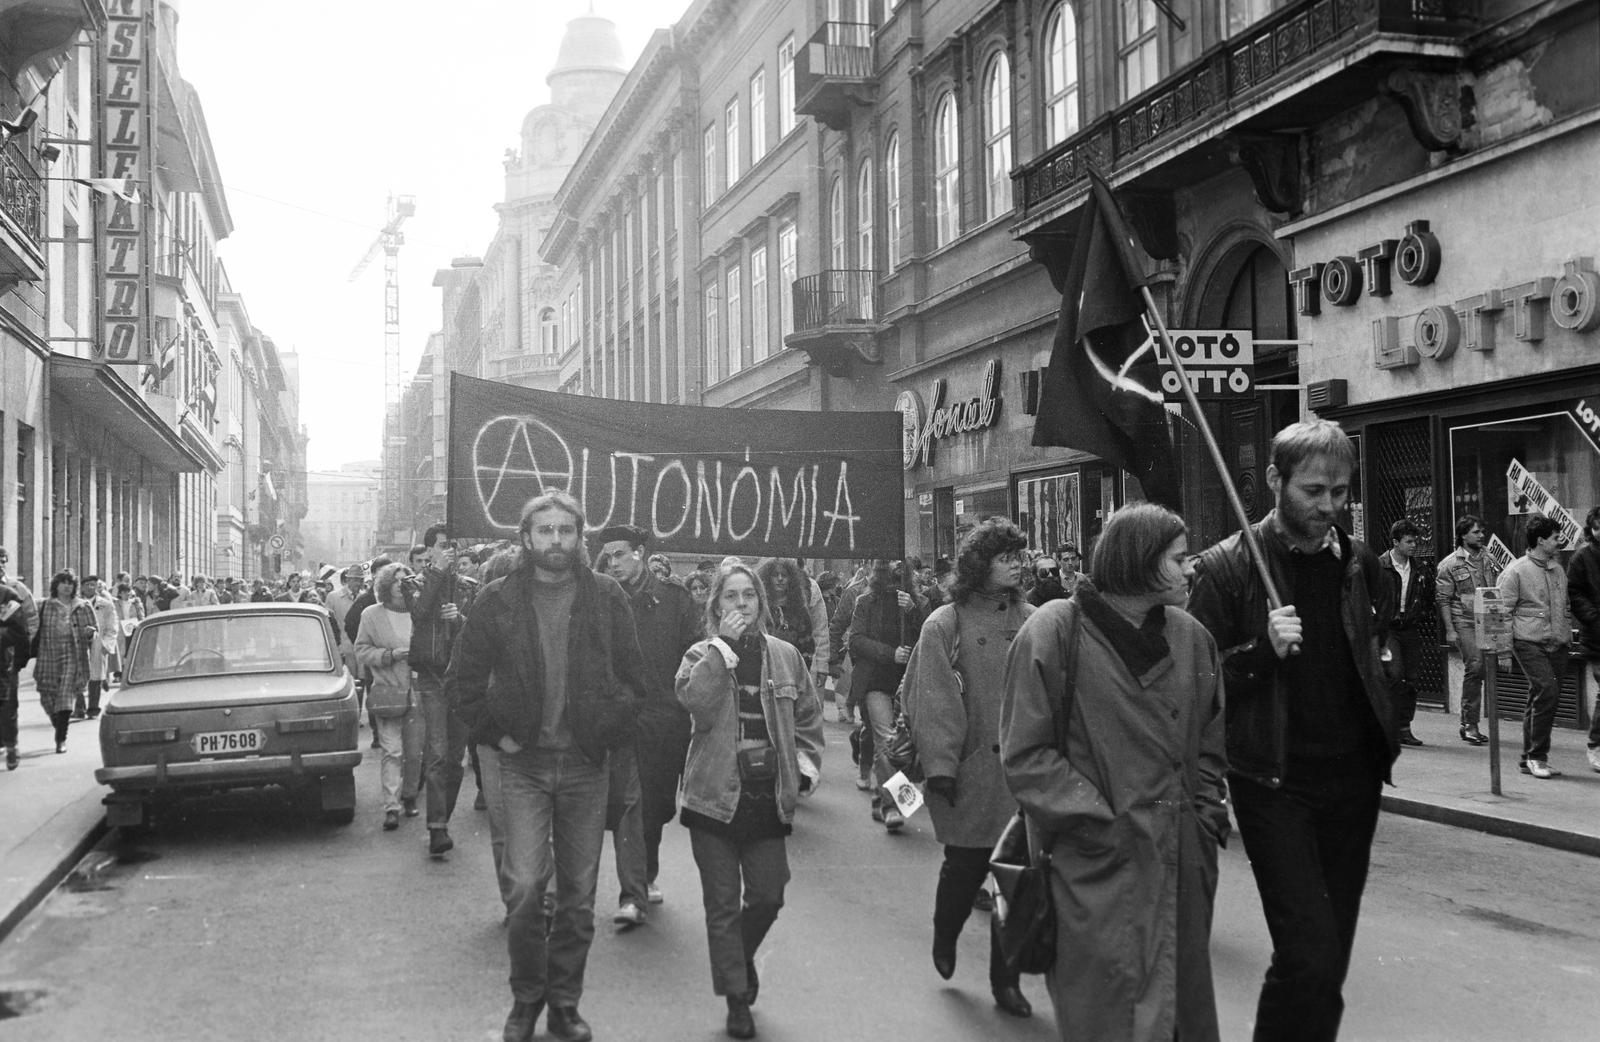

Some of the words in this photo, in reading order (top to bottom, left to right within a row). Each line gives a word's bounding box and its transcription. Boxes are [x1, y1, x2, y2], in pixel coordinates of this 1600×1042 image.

[1289, 220, 1441, 316] TOTÓ
[472, 415, 861, 550] AUTONÓMIA
[1509, 463, 1521, 483] HA
